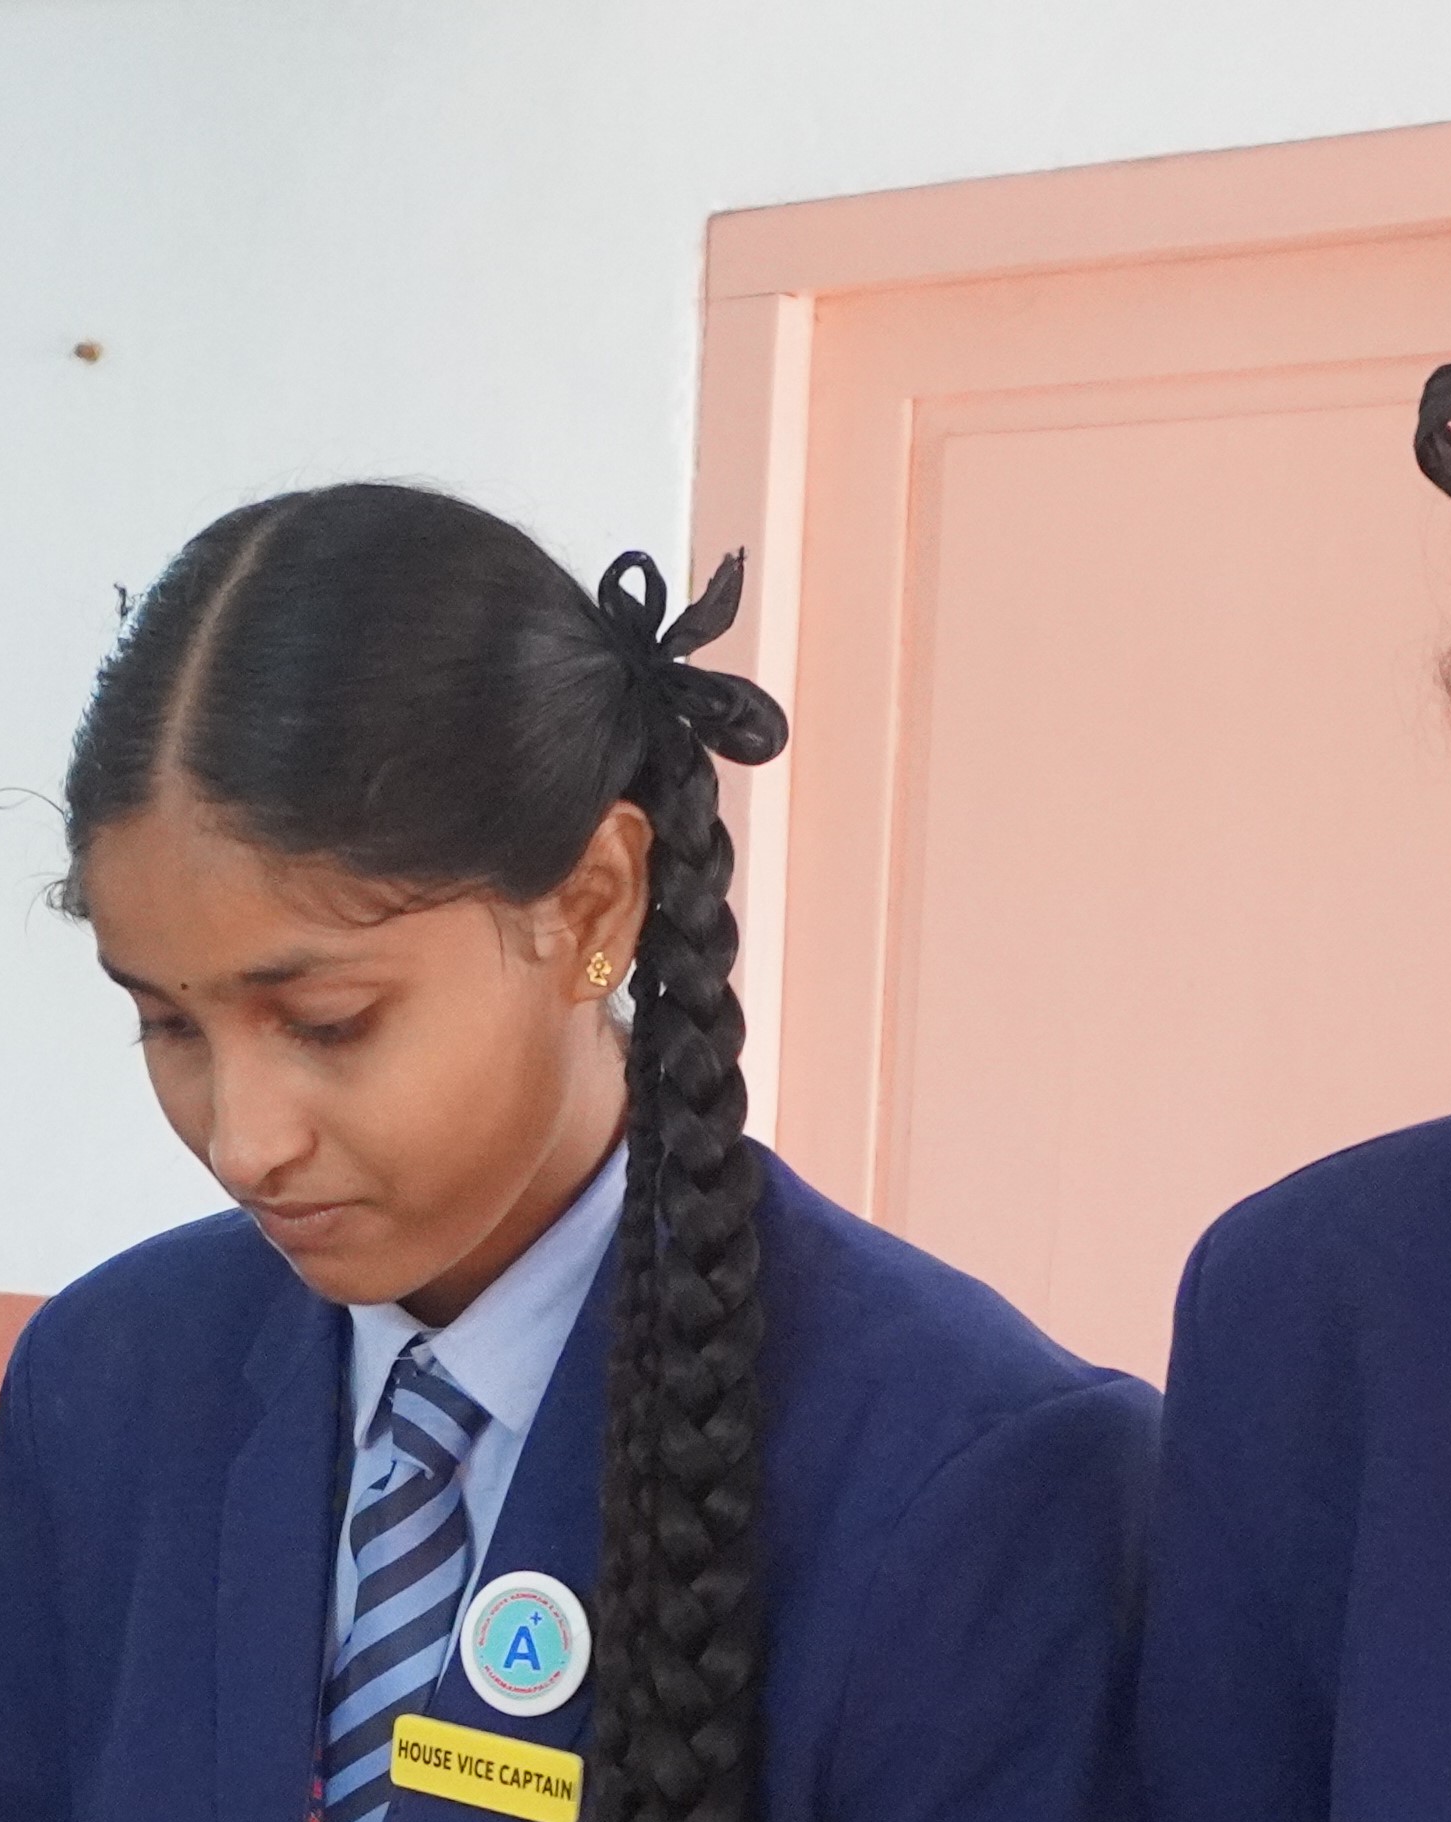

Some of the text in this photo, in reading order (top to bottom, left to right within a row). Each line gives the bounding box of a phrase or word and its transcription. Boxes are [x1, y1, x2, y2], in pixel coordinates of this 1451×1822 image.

[398, 1739, 573, 1801] HOUSE VICE CAPTAIN
